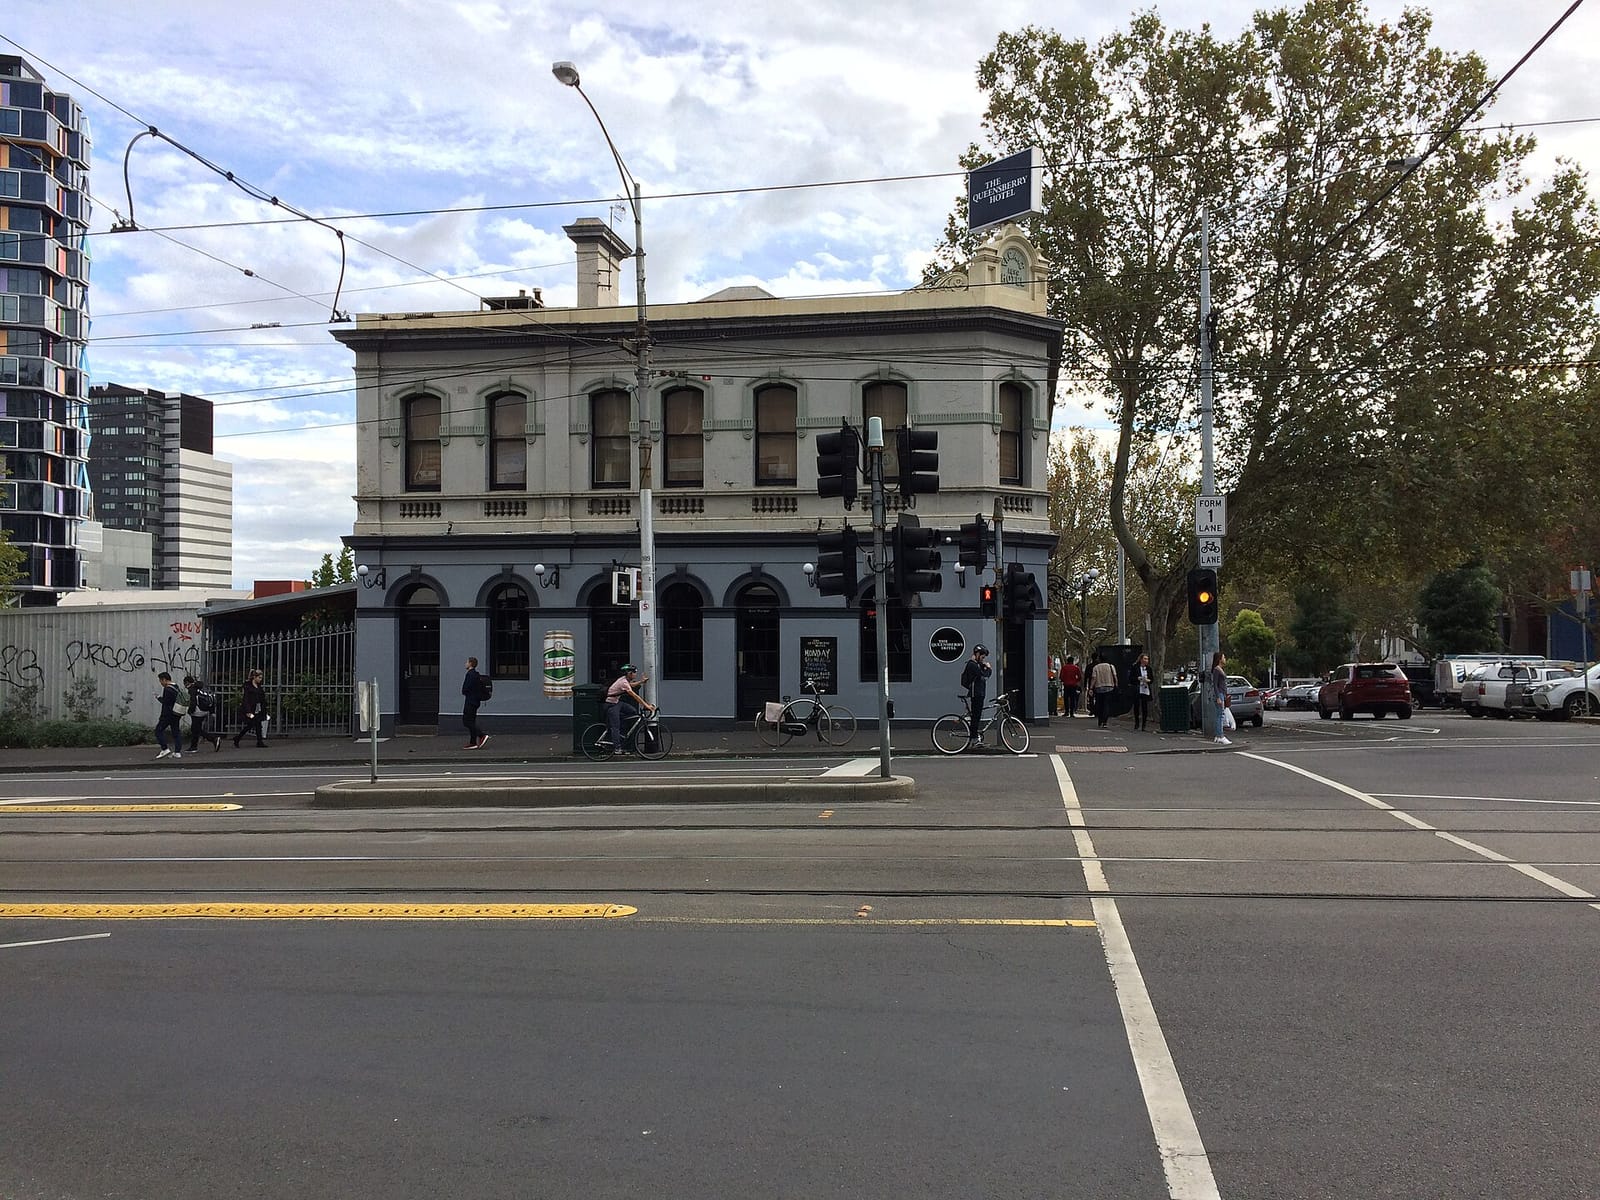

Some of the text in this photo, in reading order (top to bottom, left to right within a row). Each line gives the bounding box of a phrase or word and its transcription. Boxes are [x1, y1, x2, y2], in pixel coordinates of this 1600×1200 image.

[985, 177, 1002, 189] THE
[972, 175, 1028, 203] QUEENSBERRY
[989, 188, 1016, 204] HOTEL
[1199, 499, 1222, 507] FORM
[1207, 509, 1213, 522] 1
[1198, 524, 1222, 532] LANE
[1201, 556, 1221, 564] LANE
[804, 648, 831, 659] MONDAY
